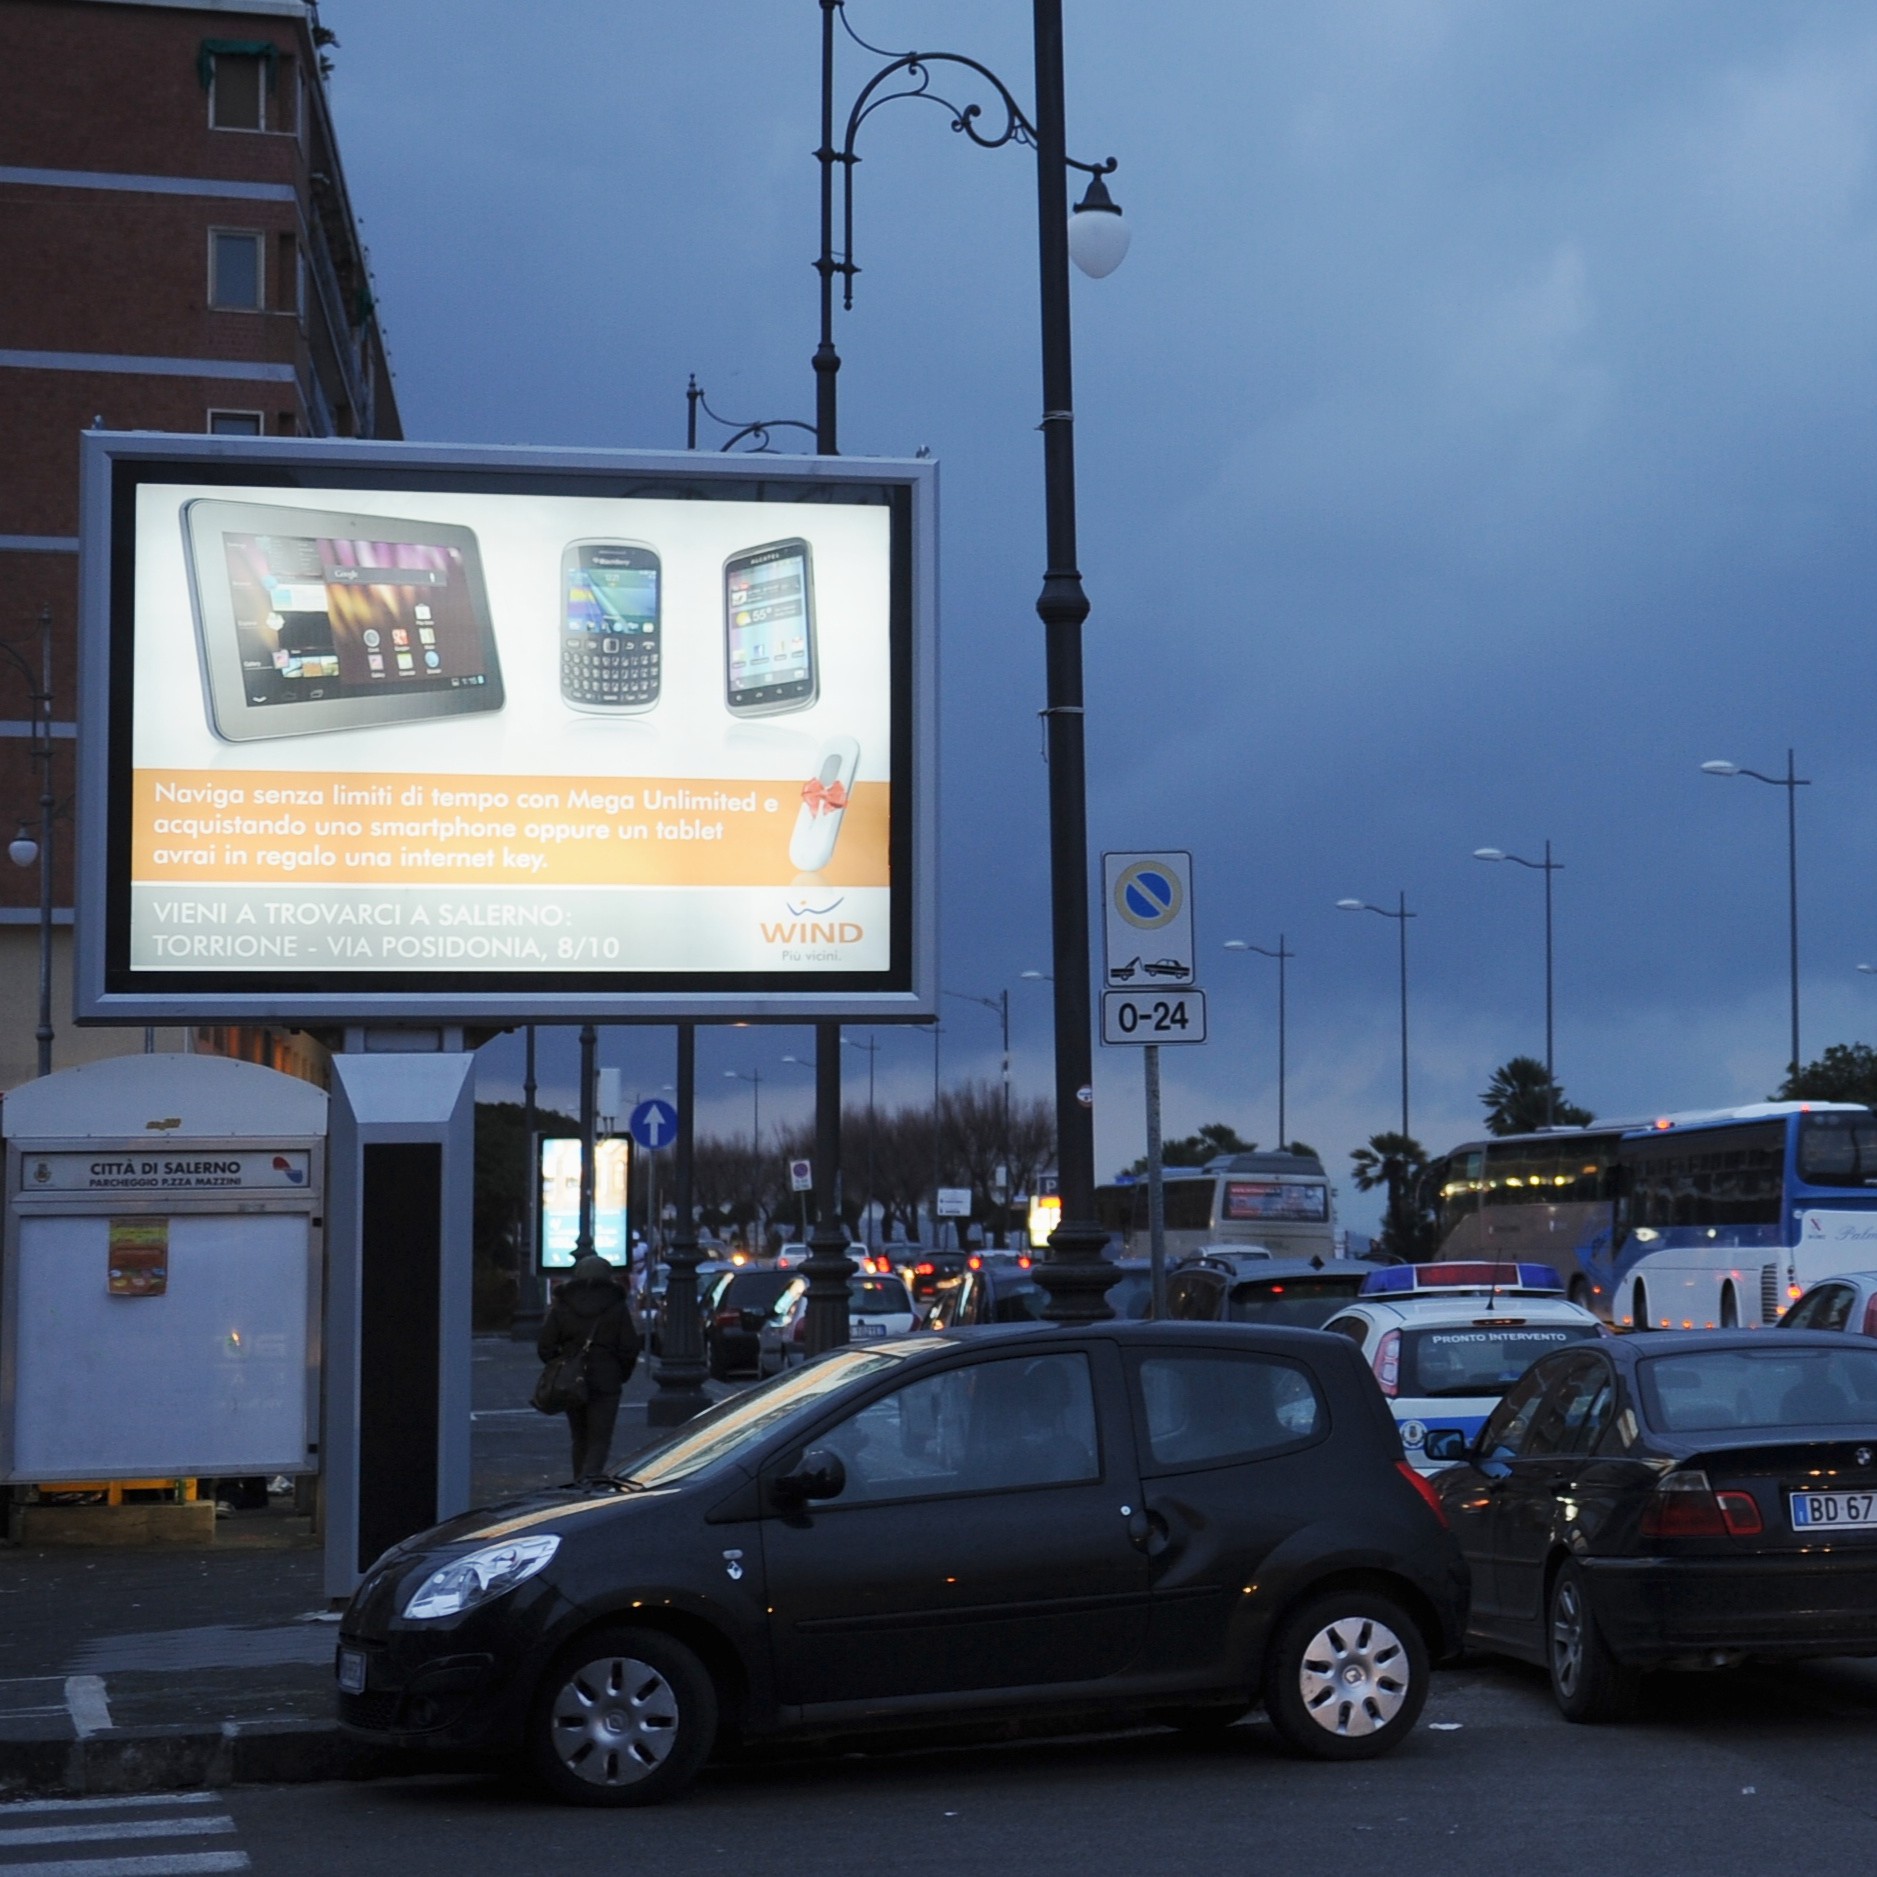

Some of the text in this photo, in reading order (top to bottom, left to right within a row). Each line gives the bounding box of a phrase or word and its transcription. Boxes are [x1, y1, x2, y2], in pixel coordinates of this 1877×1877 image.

[154, 783, 779, 816] Naviga senza limiti di tempo con Mega Unlimited e
[153, 813, 724, 846] acquistando uno smartphone oppure un tablet
[153, 844, 548, 872] avrai in regalo una internet key.
[153, 902, 572, 927] VIENI A TROVARCI A SALERNO:
[760, 922, 864, 944] WIND
[152, 934, 298, 957] TORRIONE
[327, 936, 373, 957] VIA
[382, 936, 548, 961] POSIDONIA,
[557, 937, 620, 959] 8/10
[805, 950, 842, 961] vicini.
[1118, 1001, 1189, 1033] 0-24
[90, 1159, 241, 1175] CITTÀ DI SALERNO
[89, 1177, 242, 1187] PARCHEGGIO P.ZZA MAZZINI
[1432, 1332, 1567, 1344] PRONTO INTERVENTO
